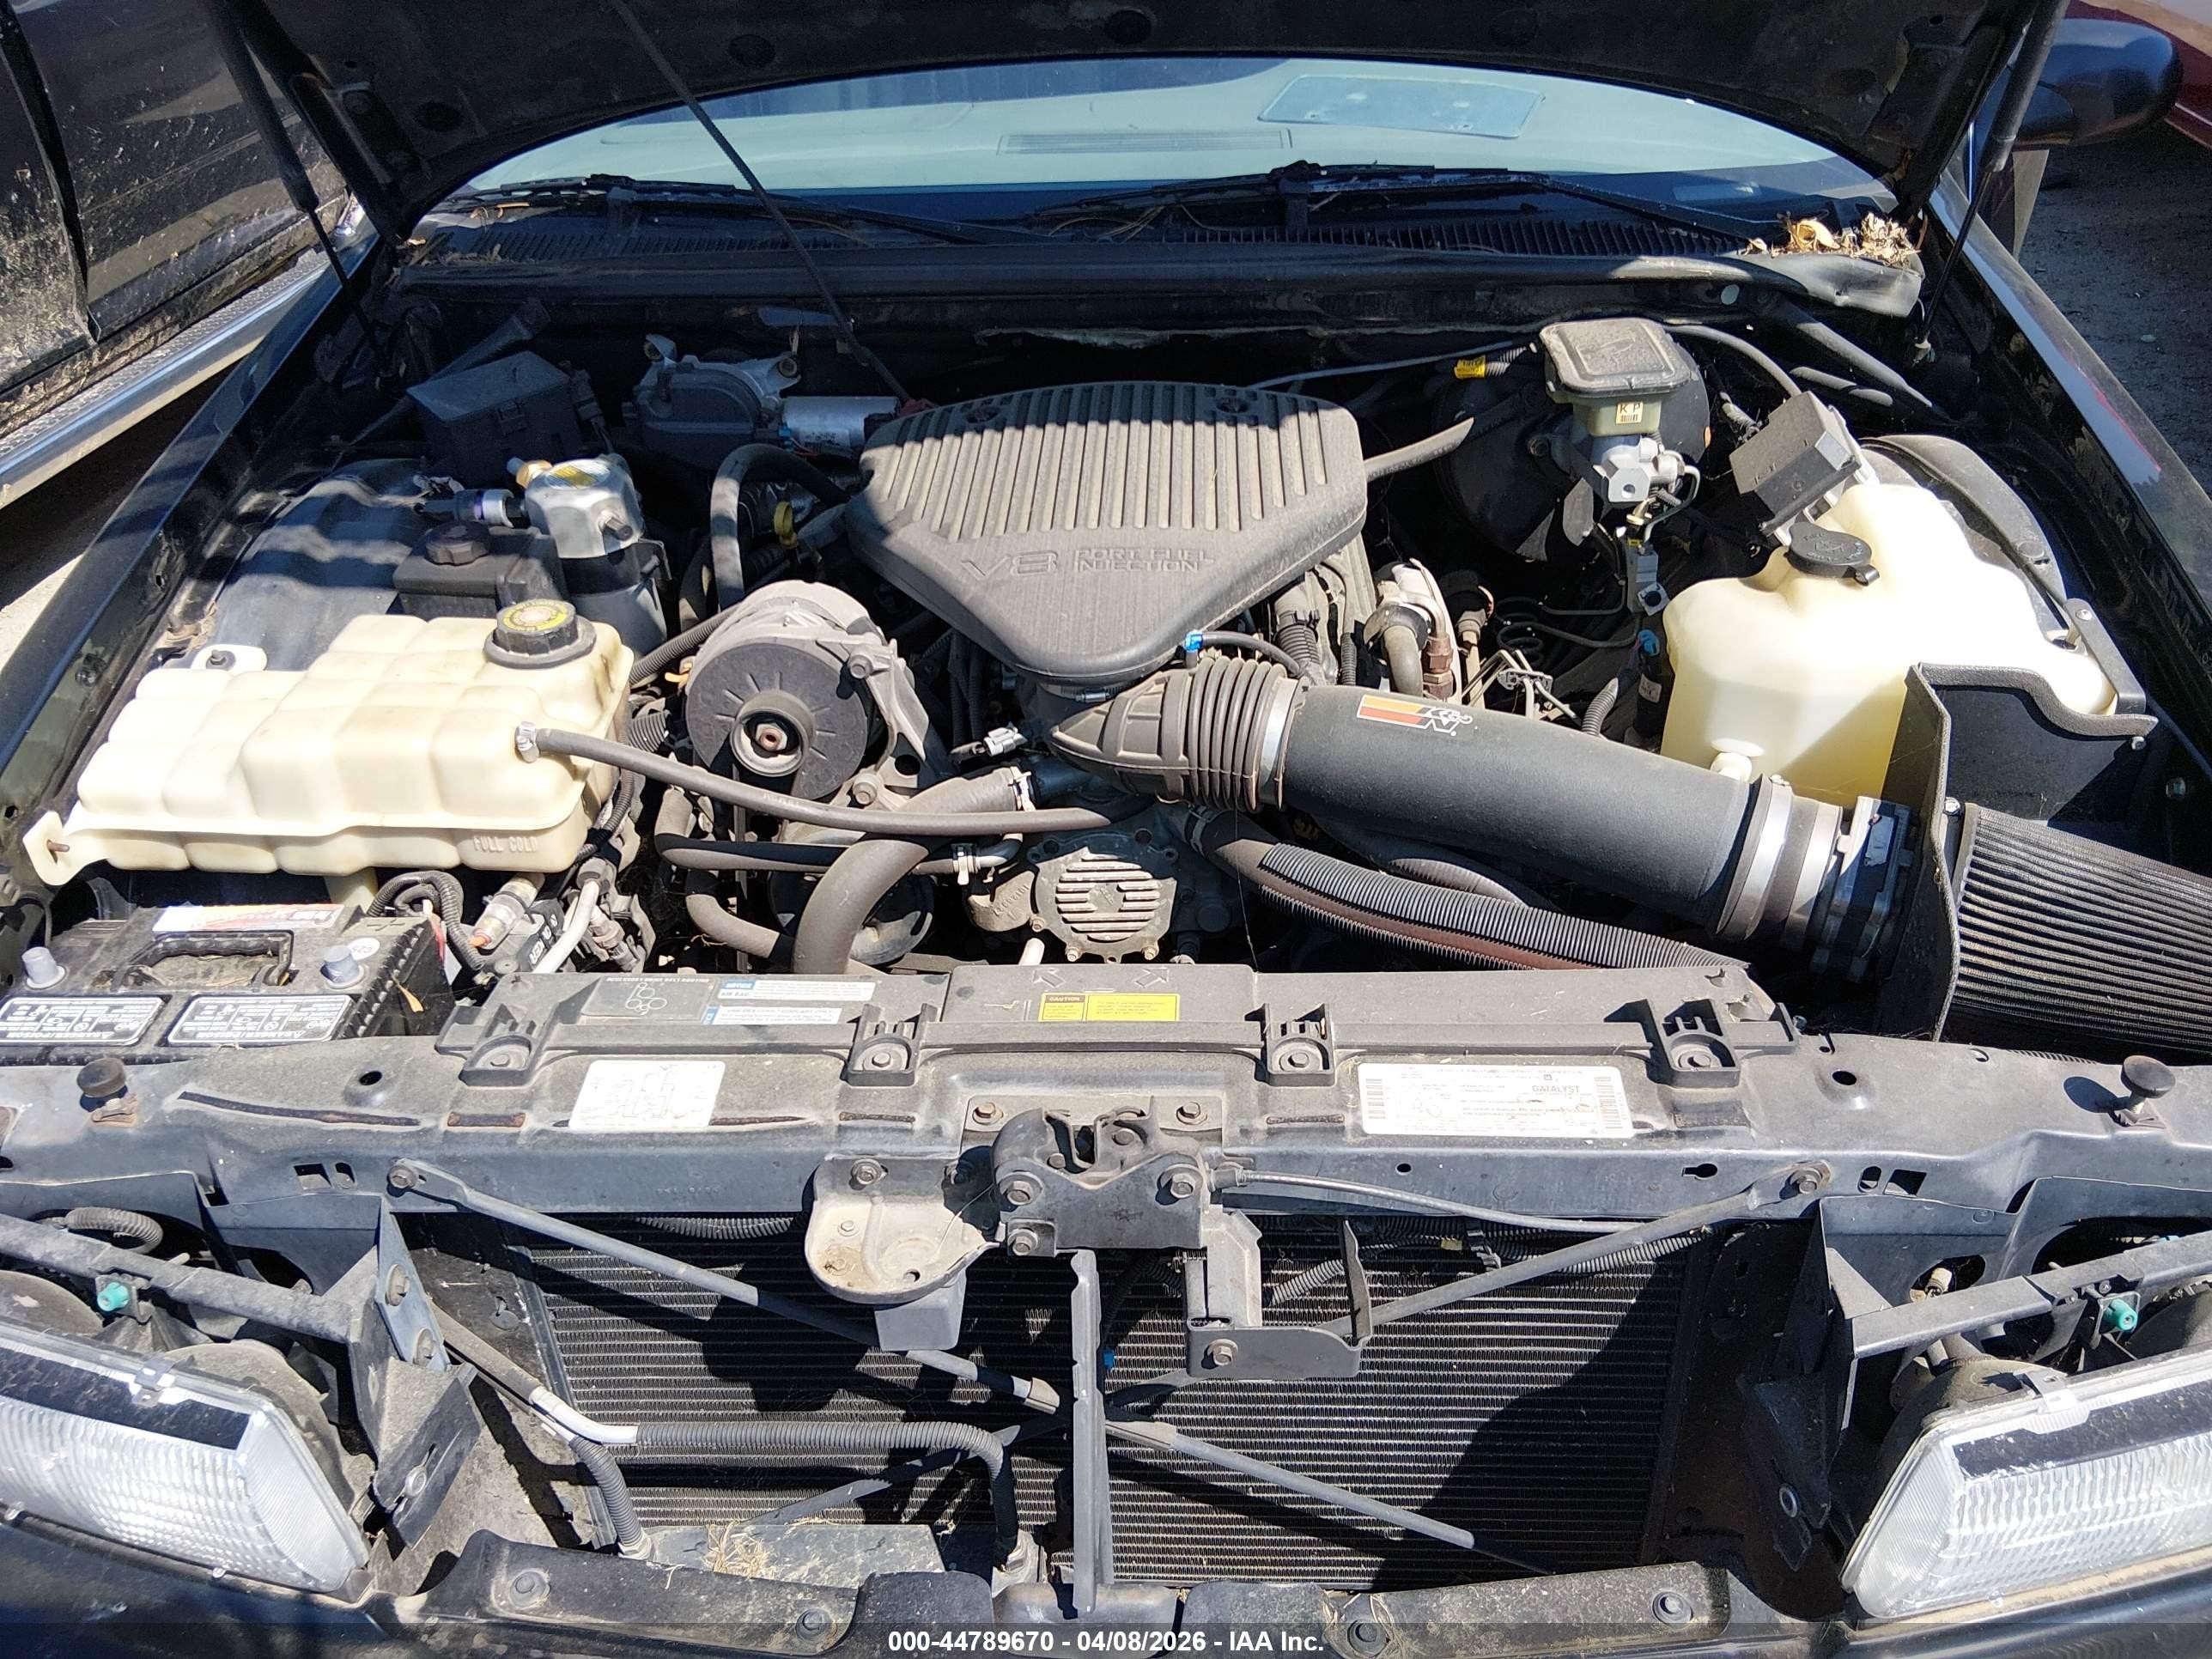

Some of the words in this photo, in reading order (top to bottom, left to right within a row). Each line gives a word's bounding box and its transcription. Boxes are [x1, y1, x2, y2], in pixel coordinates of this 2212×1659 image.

[1620, 404, 1628, 414] K
[1633, 403, 1641, 413] P
[1074, 547, 1141, 560] PORT
[1150, 548, 1215, 563] FUEL
[961, 550, 1058, 581] V8
[1074, 558, 1199, 573] INJECTION
[473, 836, 504, 852] FULL
[508, 836, 538, 853] COLD
